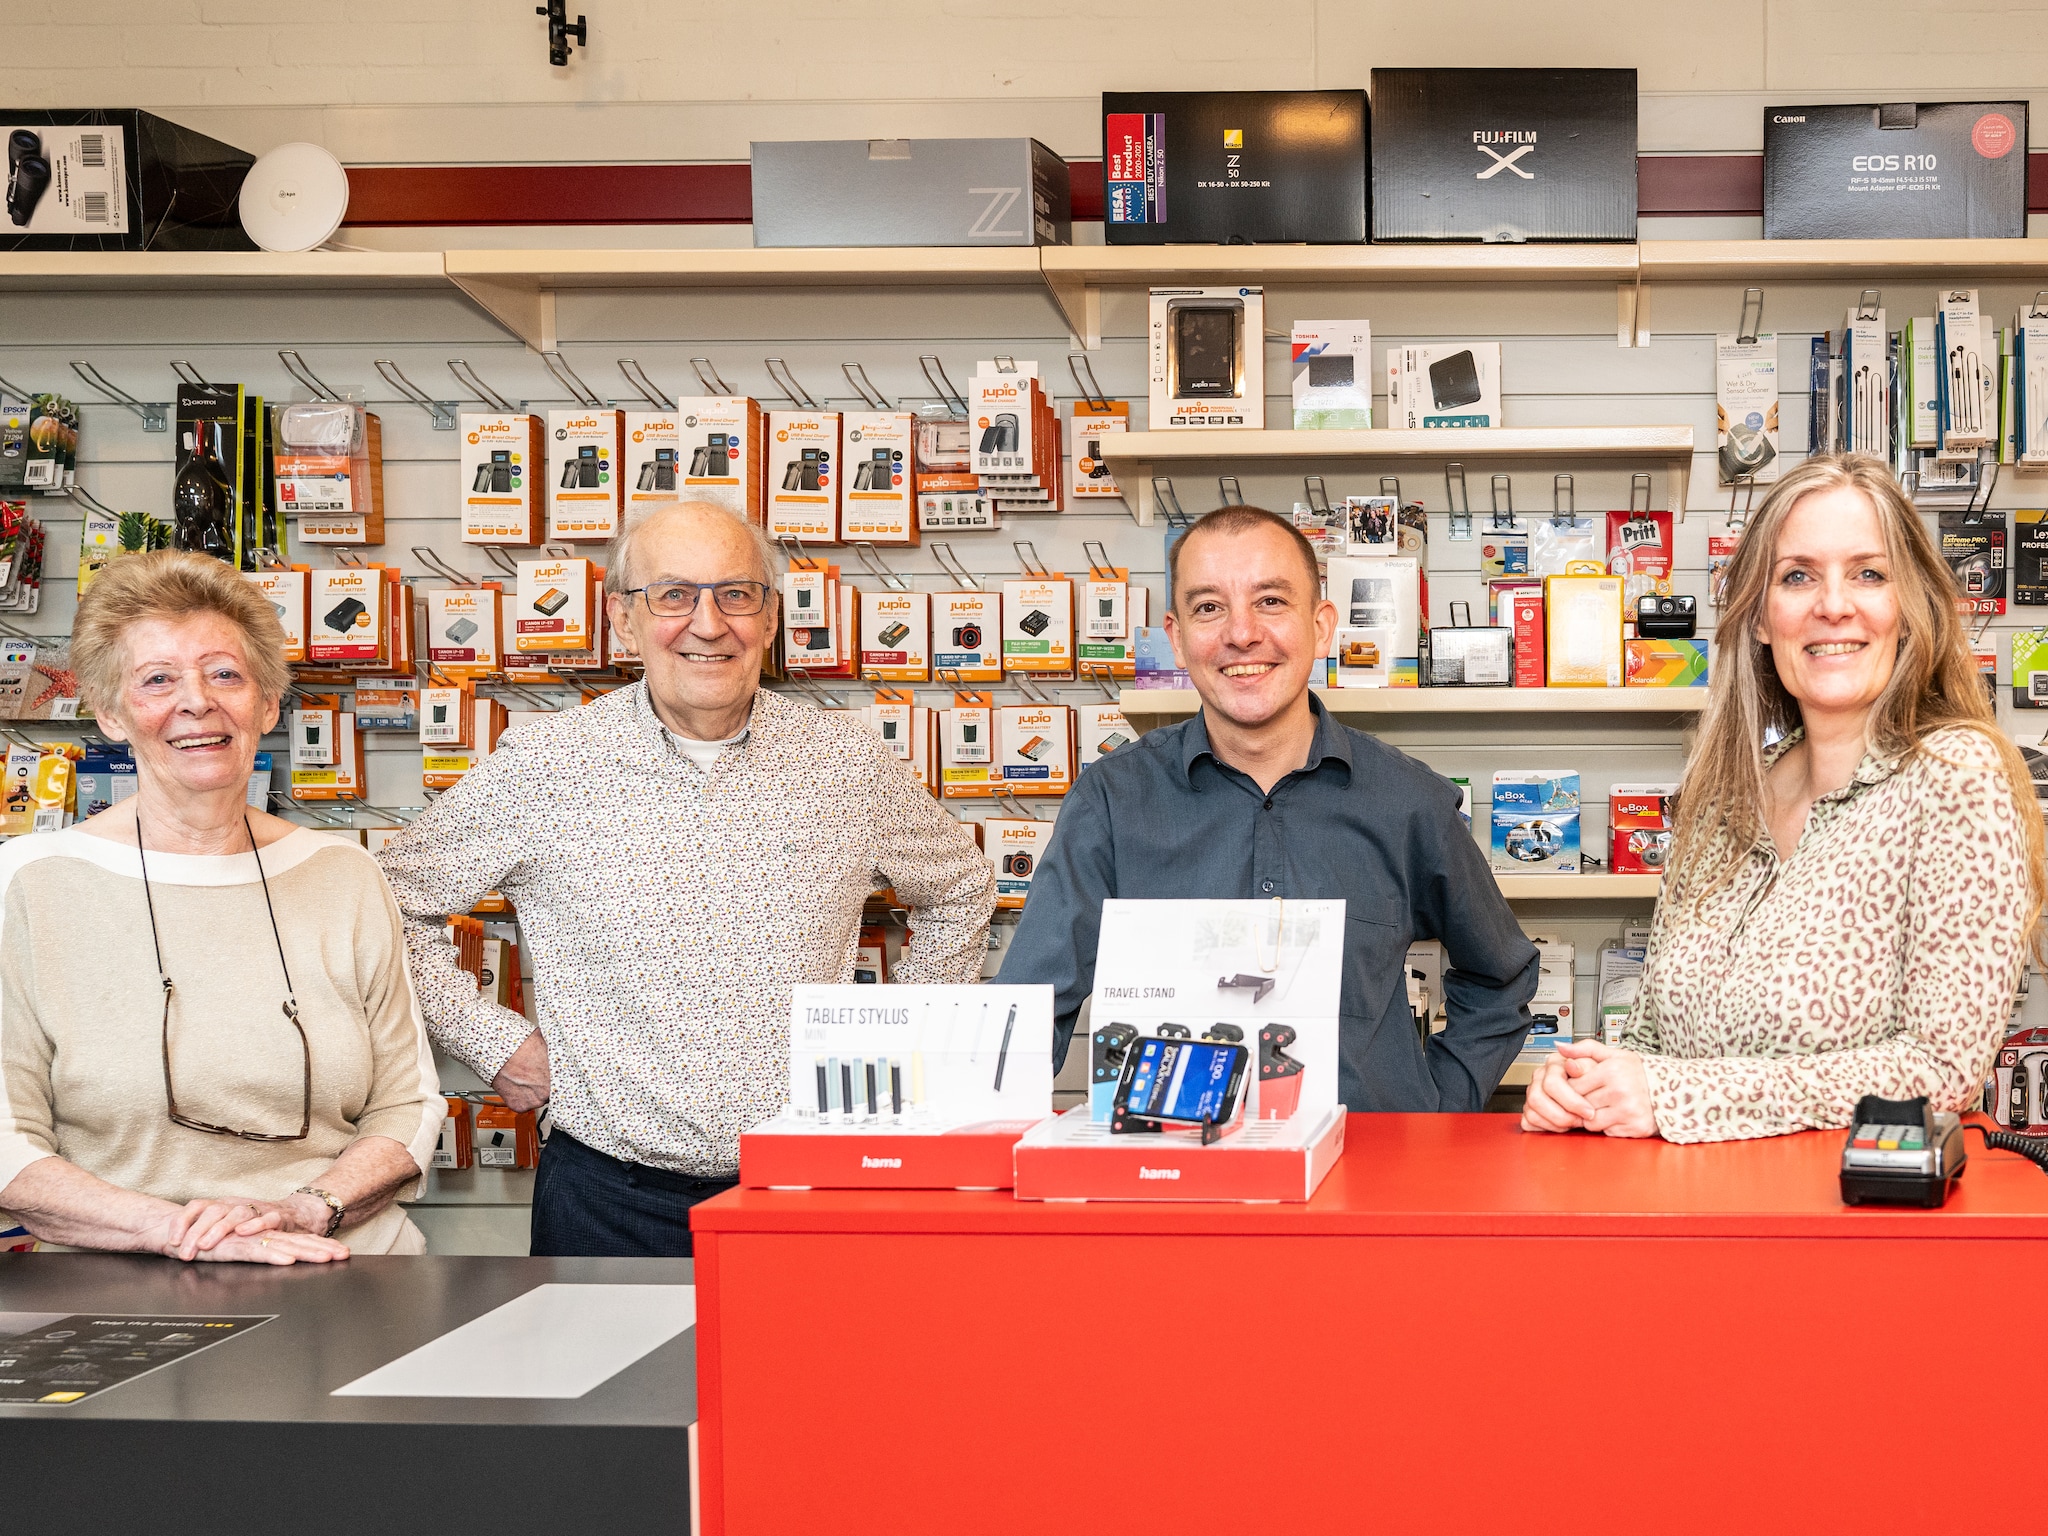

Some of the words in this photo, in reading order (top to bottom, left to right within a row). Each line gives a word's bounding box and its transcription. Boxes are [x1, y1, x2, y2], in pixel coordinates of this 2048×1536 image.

[1773, 115, 1806, 123] Canon
[1473, 131, 1537, 143] FUJIFILM
[1124, 135, 1133, 179] Product
[1158, 149, 1165, 157] 50
[1112, 154, 1121, 179] Best
[1227, 155, 1240, 167] Z
[1477, 145, 1535, 179] X
[1852, 155, 1900, 171] EOS
[1904, 155, 1937, 171] R10
[1228, 170, 1239, 178] 50
[1869, 184, 1894, 192] Adapter
[286, 191, 296, 199] kpn
[1112, 188, 1125, 222] EISA
[967, 187, 1023, 237] Z
[982, 383, 1017, 398] jupio
[1176, 402, 1209, 415] jupio
[479, 420, 510, 432] jupio
[567, 416, 597, 429] jupio
[644, 419, 674, 431] jupio
[788, 419, 819, 431] jupio
[1087, 420, 1111, 431] jupio
[280, 460, 307, 472] jupio
[922, 476, 949, 488] jupio
[1622, 525, 1656, 542] Pritt
[328, 573, 363, 587] jupio
[794, 574, 814, 583] jupio
[1019, 585, 1054, 599] jupio
[1096, 584, 1116, 592] jupio
[878, 597, 911, 610] jupio
[950, 598, 983, 611] jupio
[358, 692, 379, 702] jupio
[430, 690, 451, 699] jupio
[302, 712, 323, 720] jupio
[880, 706, 900, 714] jupio
[960, 710, 980, 718] jupio
[1018, 710, 1051, 725] jupio
[1495, 792, 1525, 801] LeBox
[1618, 804, 1648, 813] LeBox
[1002, 826, 1036, 839] jupio
[1104, 988, 1140, 998] TRAVEL
[1144, 988, 1175, 998] STAND
[806, 1008, 855, 1024] TABLET
[859, 1008, 909, 1024] STYLUS
[805, 1029, 826, 1040] MINI
[1211, 1050, 1229, 1080] 11:00
[862, 1156, 902, 1169] hama
[1140, 1166, 1180, 1180] hama
